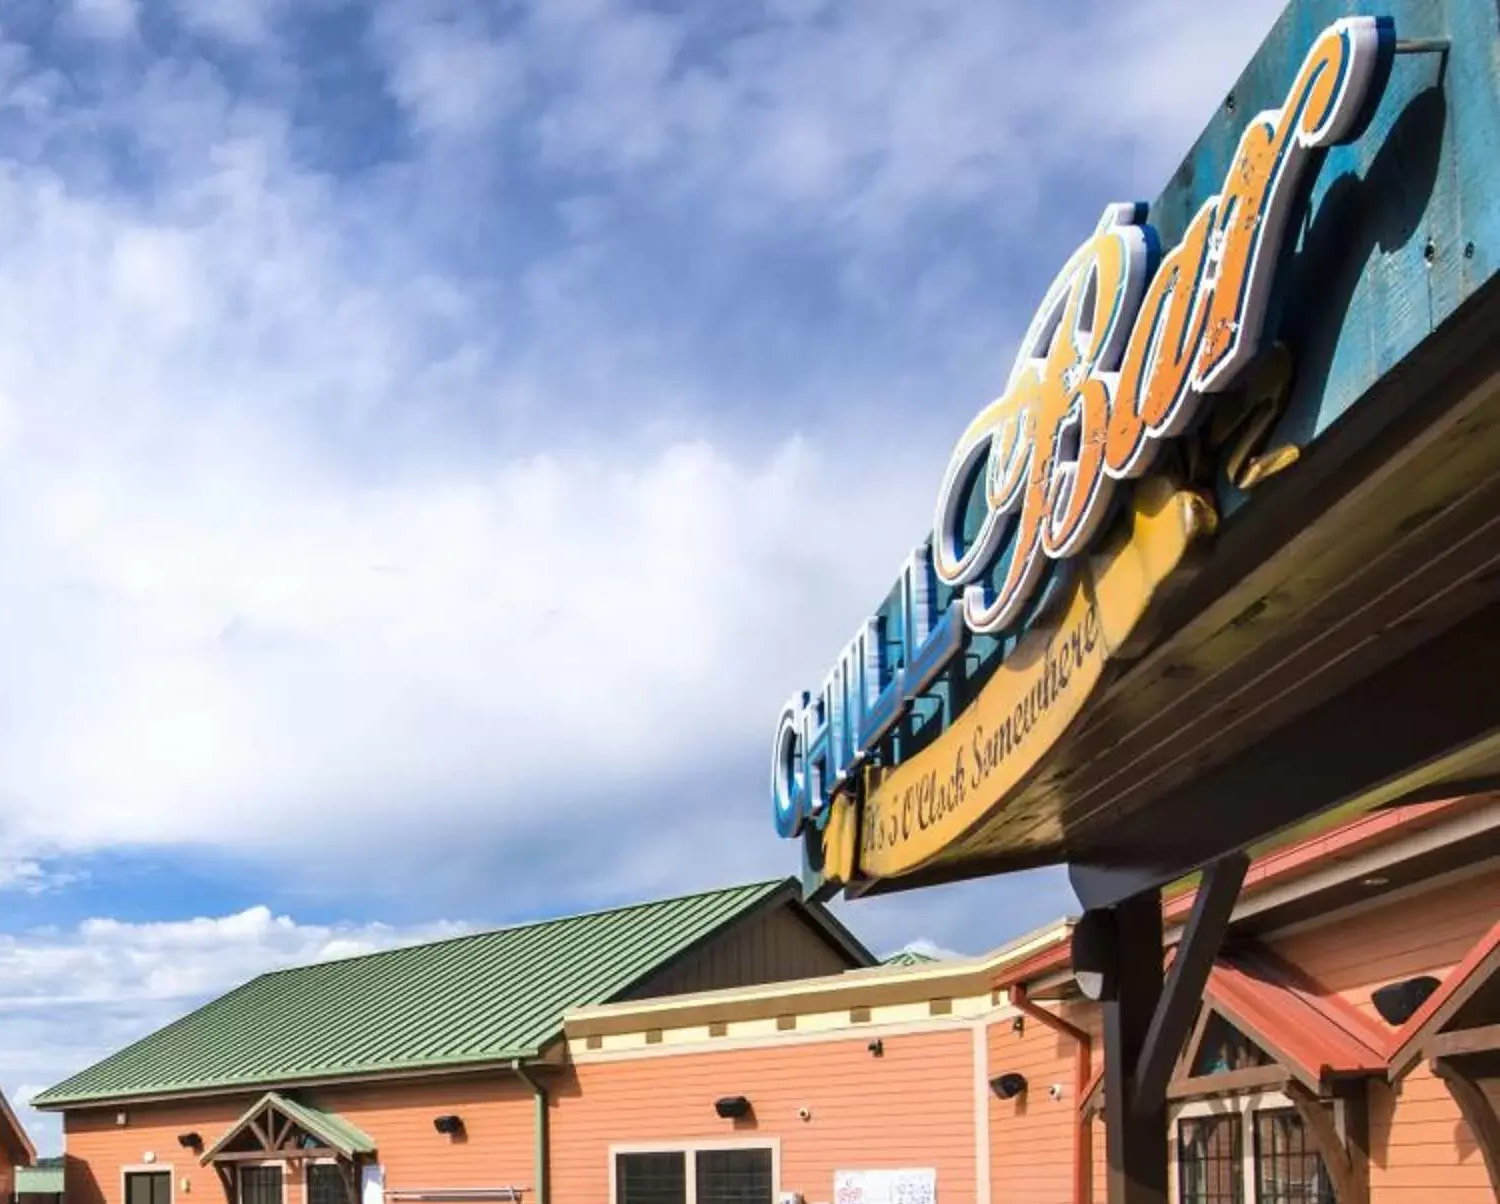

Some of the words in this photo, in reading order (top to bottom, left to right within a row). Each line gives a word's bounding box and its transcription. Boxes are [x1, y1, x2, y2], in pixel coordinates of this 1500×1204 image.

[933, 14, 1396, 634] Bar
[771, 543, 965, 839] CHILL
[971, 604, 1100, 790] Somewhere
